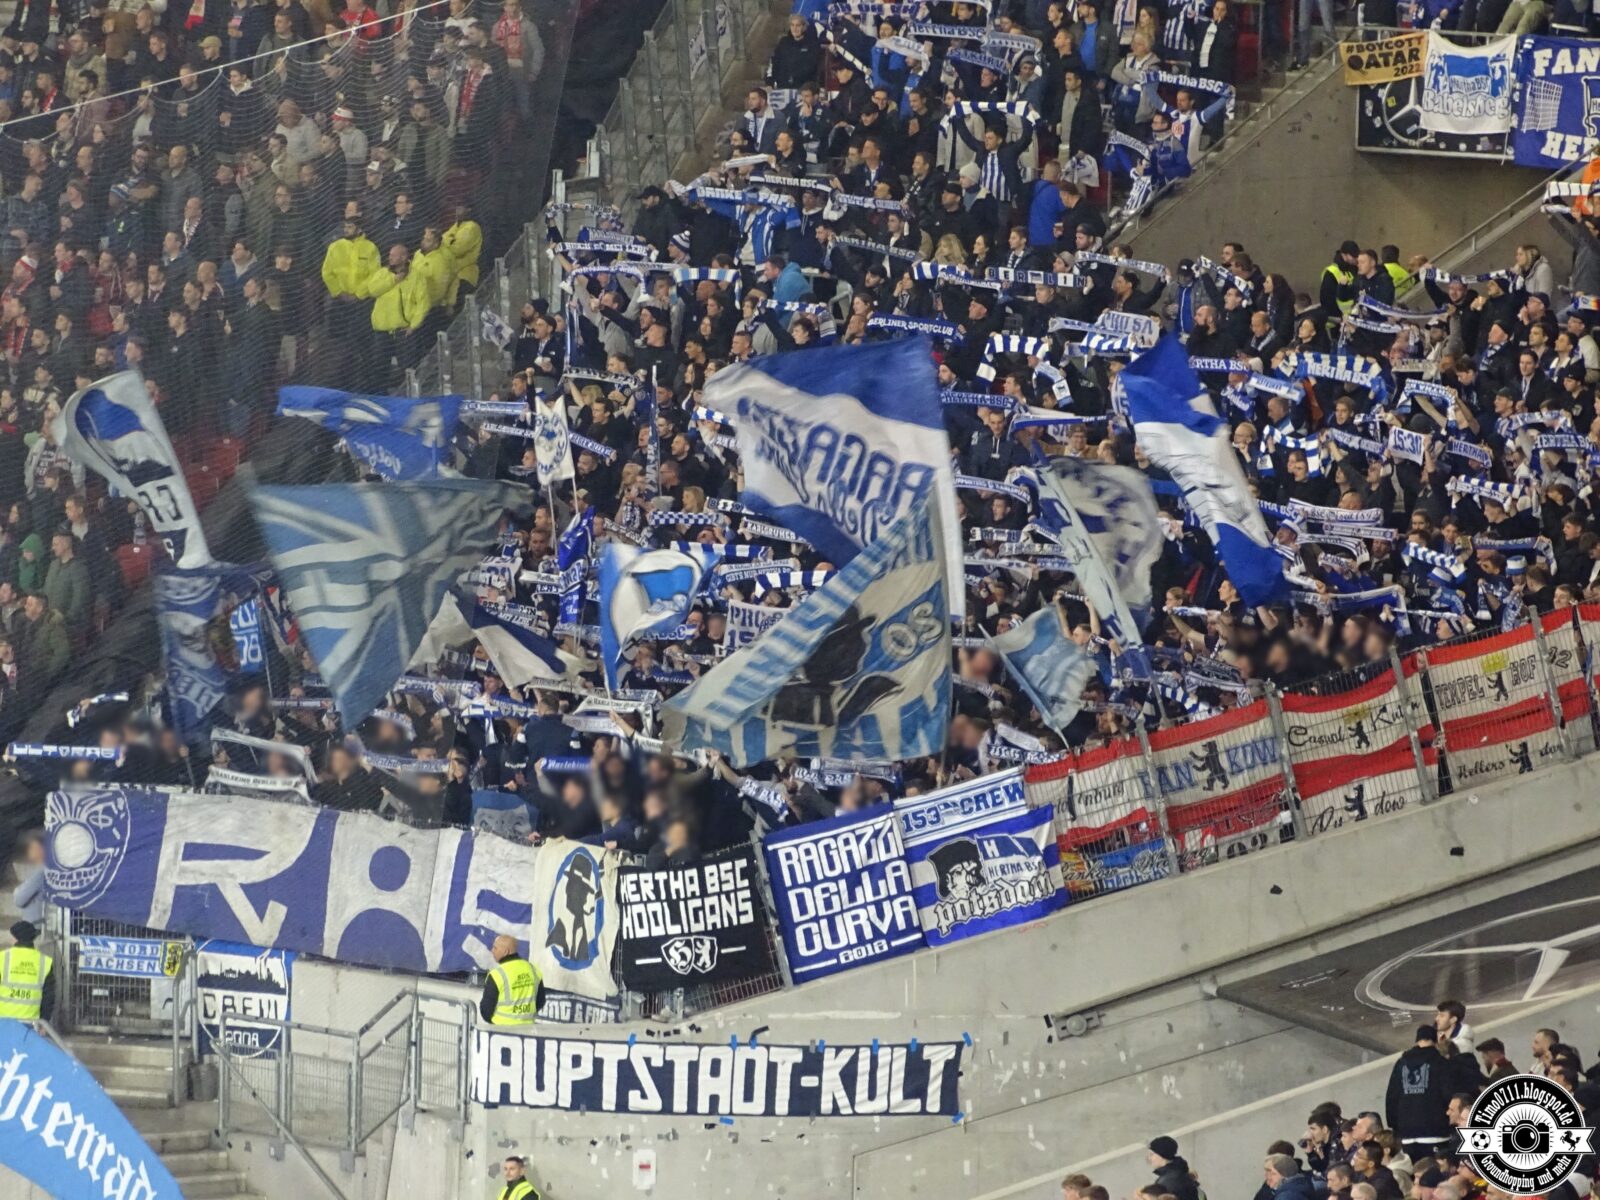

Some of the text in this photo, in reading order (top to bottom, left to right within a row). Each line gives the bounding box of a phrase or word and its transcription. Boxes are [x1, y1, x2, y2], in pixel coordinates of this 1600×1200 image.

[1346, 34, 1424, 54] #BOYCOTT
[1347, 47, 1421, 75] QATAR
[1393, 63, 1422, 77] 2022
[1158, 70, 1224, 93] Hertha BSC
[1422, 88, 1511, 119] Babelsberg
[867, 315, 954, 336] BERLINER SPORTCLUB
[959, 779, 1027, 816] CREW
[777, 816, 906, 888] RAGAZZI
[620, 857, 750, 904] HERTHA BSC
[786, 859, 913, 924] DELLA
[620, 891, 755, 941] HOOLIGANS
[795, 894, 921, 957] CURVA
[115, 942, 159, 956] NORD
[84, 956, 157, 972] SACHSEN
[10, 988, 31, 1000] 2486
[470, 1027, 957, 1116] HAUPTSTADT-KULT
